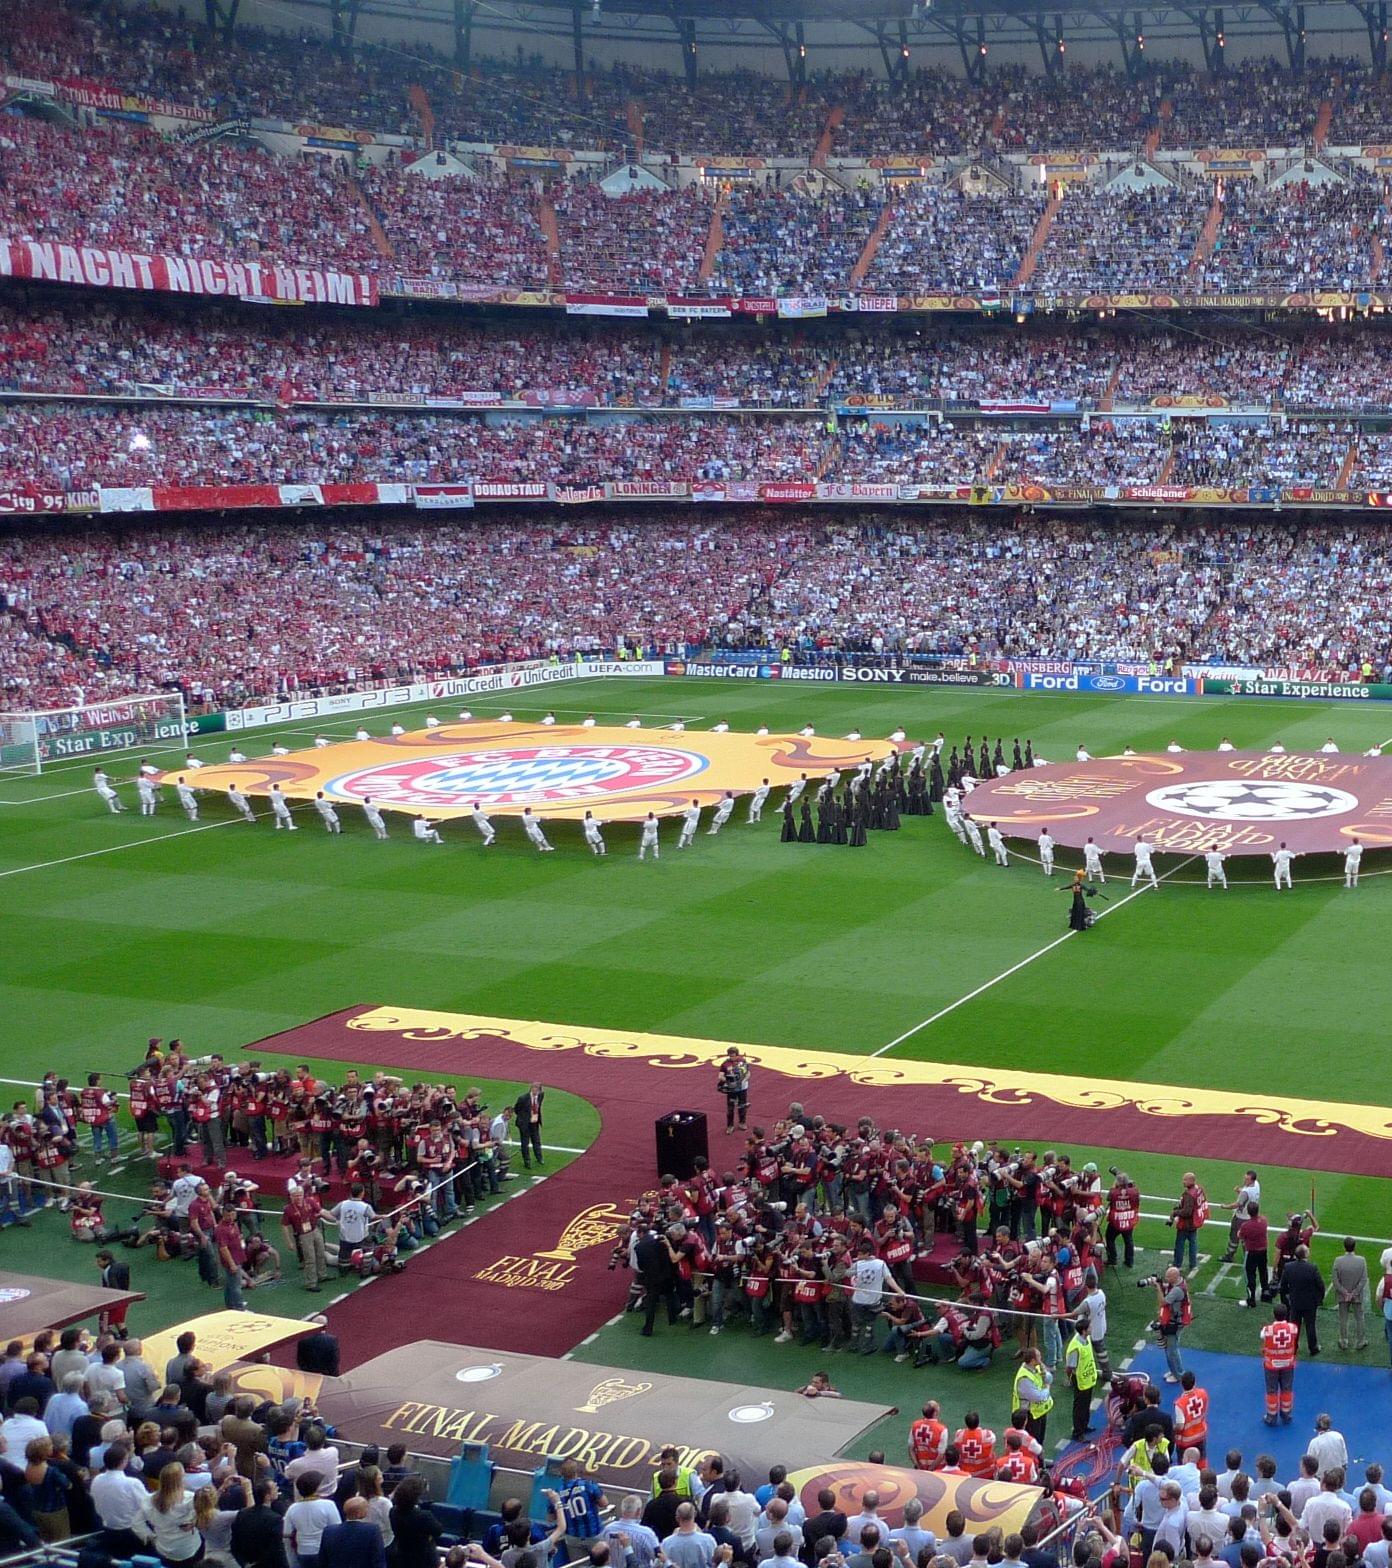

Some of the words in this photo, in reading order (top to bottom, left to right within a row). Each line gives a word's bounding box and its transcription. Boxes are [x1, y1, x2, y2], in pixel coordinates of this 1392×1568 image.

[28, 242, 155, 290] NACHT
[164, 255, 263, 296] NICHT
[274, 266, 373, 307] HEIM!
[860, 298, 896, 310] STIEPEL
[1196, 298, 1219, 307] FINAL
[1221, 297, 1250, 307] MADRID
[474, 483, 546, 497] DONAUSTAUF
[823, 484, 845, 498] FC
[852, 484, 893, 498] Bayern
[1309, 491, 1335, 503] ADRID
[525, 664, 575, 685] UniCredit
[686, 663, 758, 679] MasterCard
[781, 665, 834, 680] Maestro
[842, 667, 905, 682] SONY
[910, 672, 979, 683] make.believe
[991, 673, 1010, 686] 3D
[447, 675, 504, 697] UniCredit
[1029, 674, 1079, 690] Ford
[1096, 676, 1120, 688] Ford
[1137, 677, 1187, 694] Ford
[1245, 680, 1278, 695] Star
[1282, 682, 1370, 699] Experience
[361, 688, 412, 707] PS3
[264, 702, 319, 723] PS3
[56, 734, 94, 755] Star
[100, 718, 200, 749] Expience
[430, 753, 508, 769] FC
[535, 747, 685, 779] BAYERN
[1104, 823, 1275, 845] MADRID
[1142, 818, 1258, 835] FINAL
[1149, 838, 1234, 852] 2010
[887, 1244, 911, 1261] PHOTO
[486, 1255, 580, 1283] FINAL
[472, 1269, 539, 1288] MADRID
[533, 1278, 567, 1291] 2010
[380, 1400, 499, 1445] FINAL
[493, 1420, 652, 1472] MADRID
